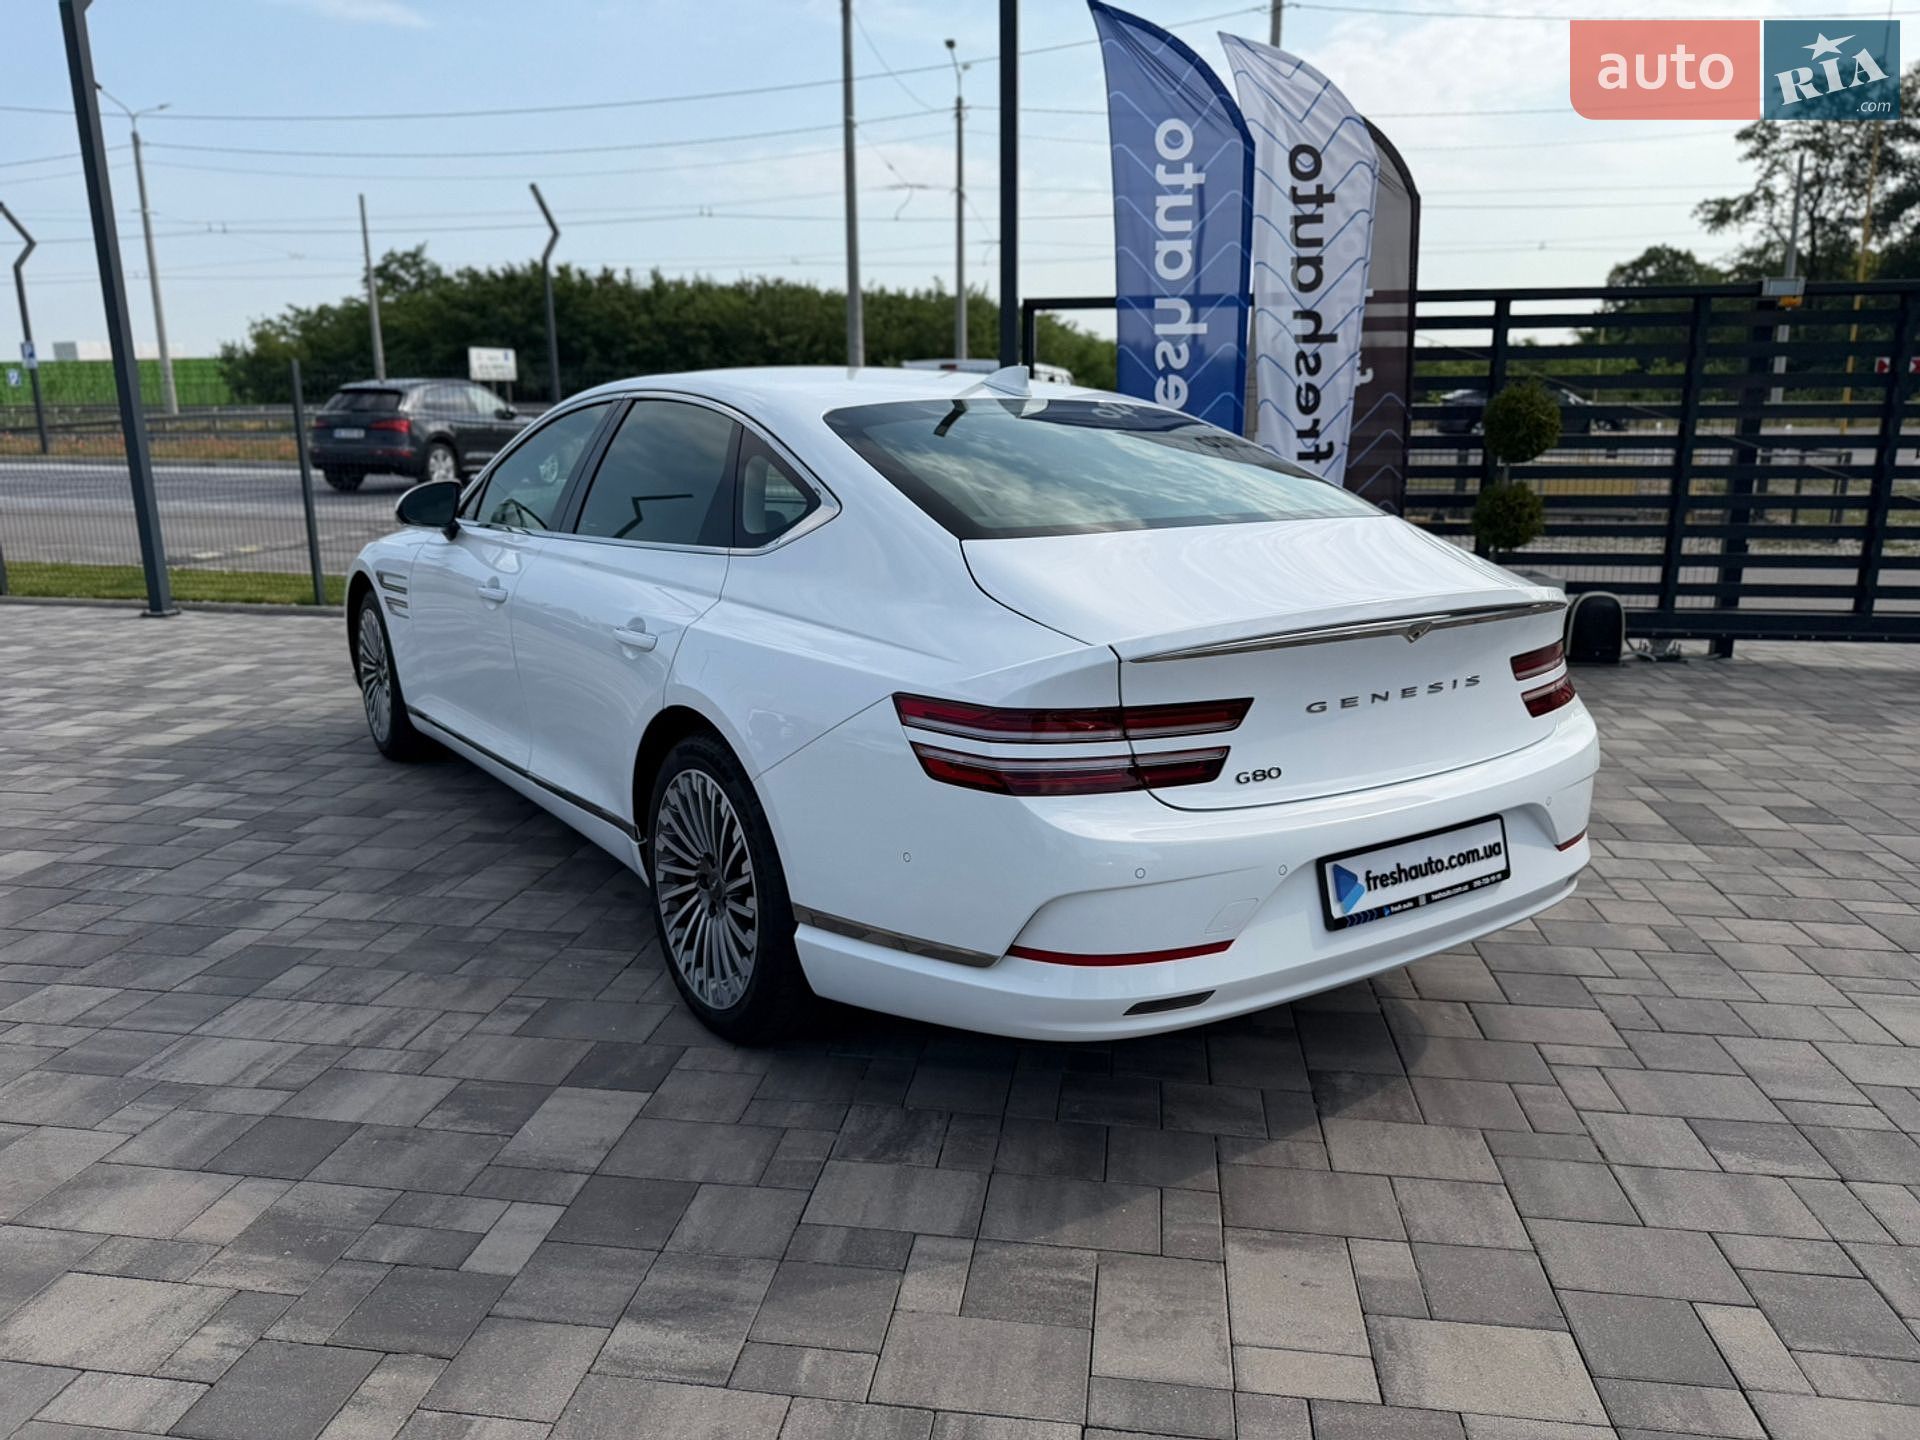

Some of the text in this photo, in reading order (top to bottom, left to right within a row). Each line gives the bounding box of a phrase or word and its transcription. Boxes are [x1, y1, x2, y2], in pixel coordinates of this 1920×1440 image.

[1306, 675, 1480, 714] GENESIS
[1235, 766, 1282, 785] G80
[1365, 841, 1502, 892] freshauto.com.ua
